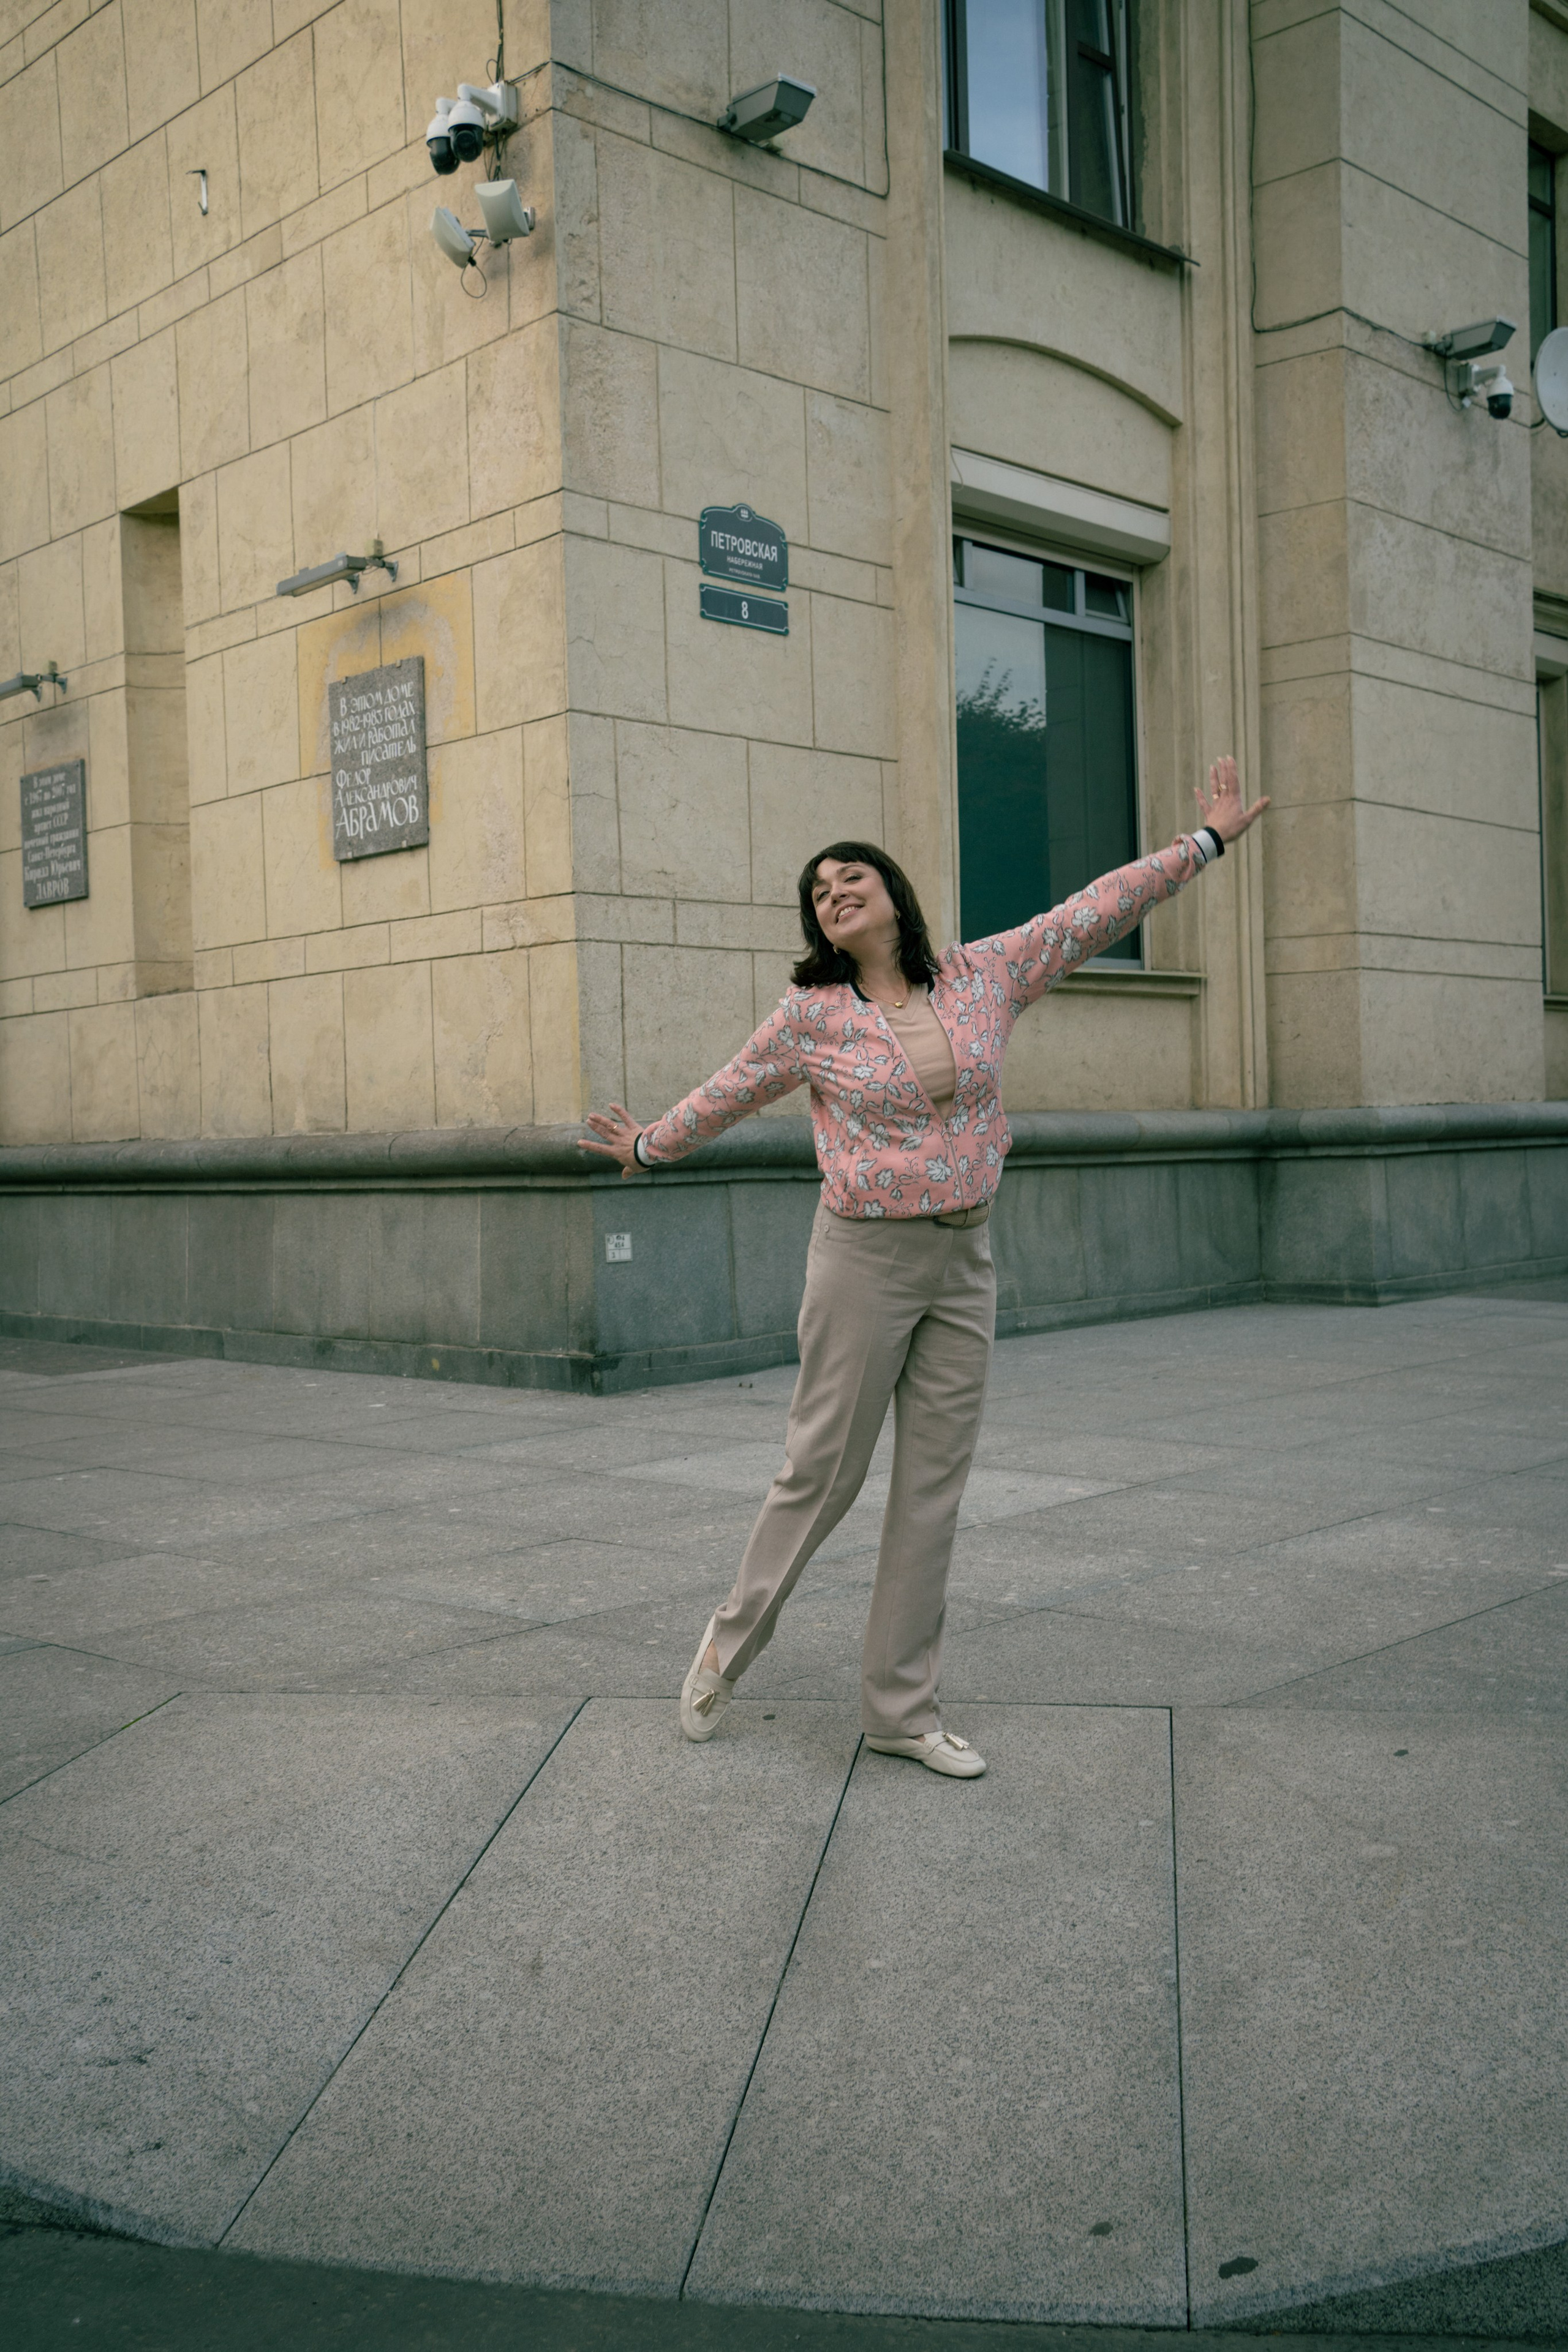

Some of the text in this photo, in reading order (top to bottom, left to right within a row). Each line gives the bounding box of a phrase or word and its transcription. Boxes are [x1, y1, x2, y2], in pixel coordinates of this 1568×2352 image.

[710, 530, 778, 562] ПЕТРОВСКАЯ
[726, 556, 763, 570] НАБЕРЕЖНАЯ
[741, 601, 749, 619] 8
[340, 697, 347, 717] В
[341, 709, 383, 736] 1982-1983
[53, 812, 69, 827] СССР
[51, 859, 81, 878] Юрьевич
[36, 877, 69, 900] ЛАВРОВ
